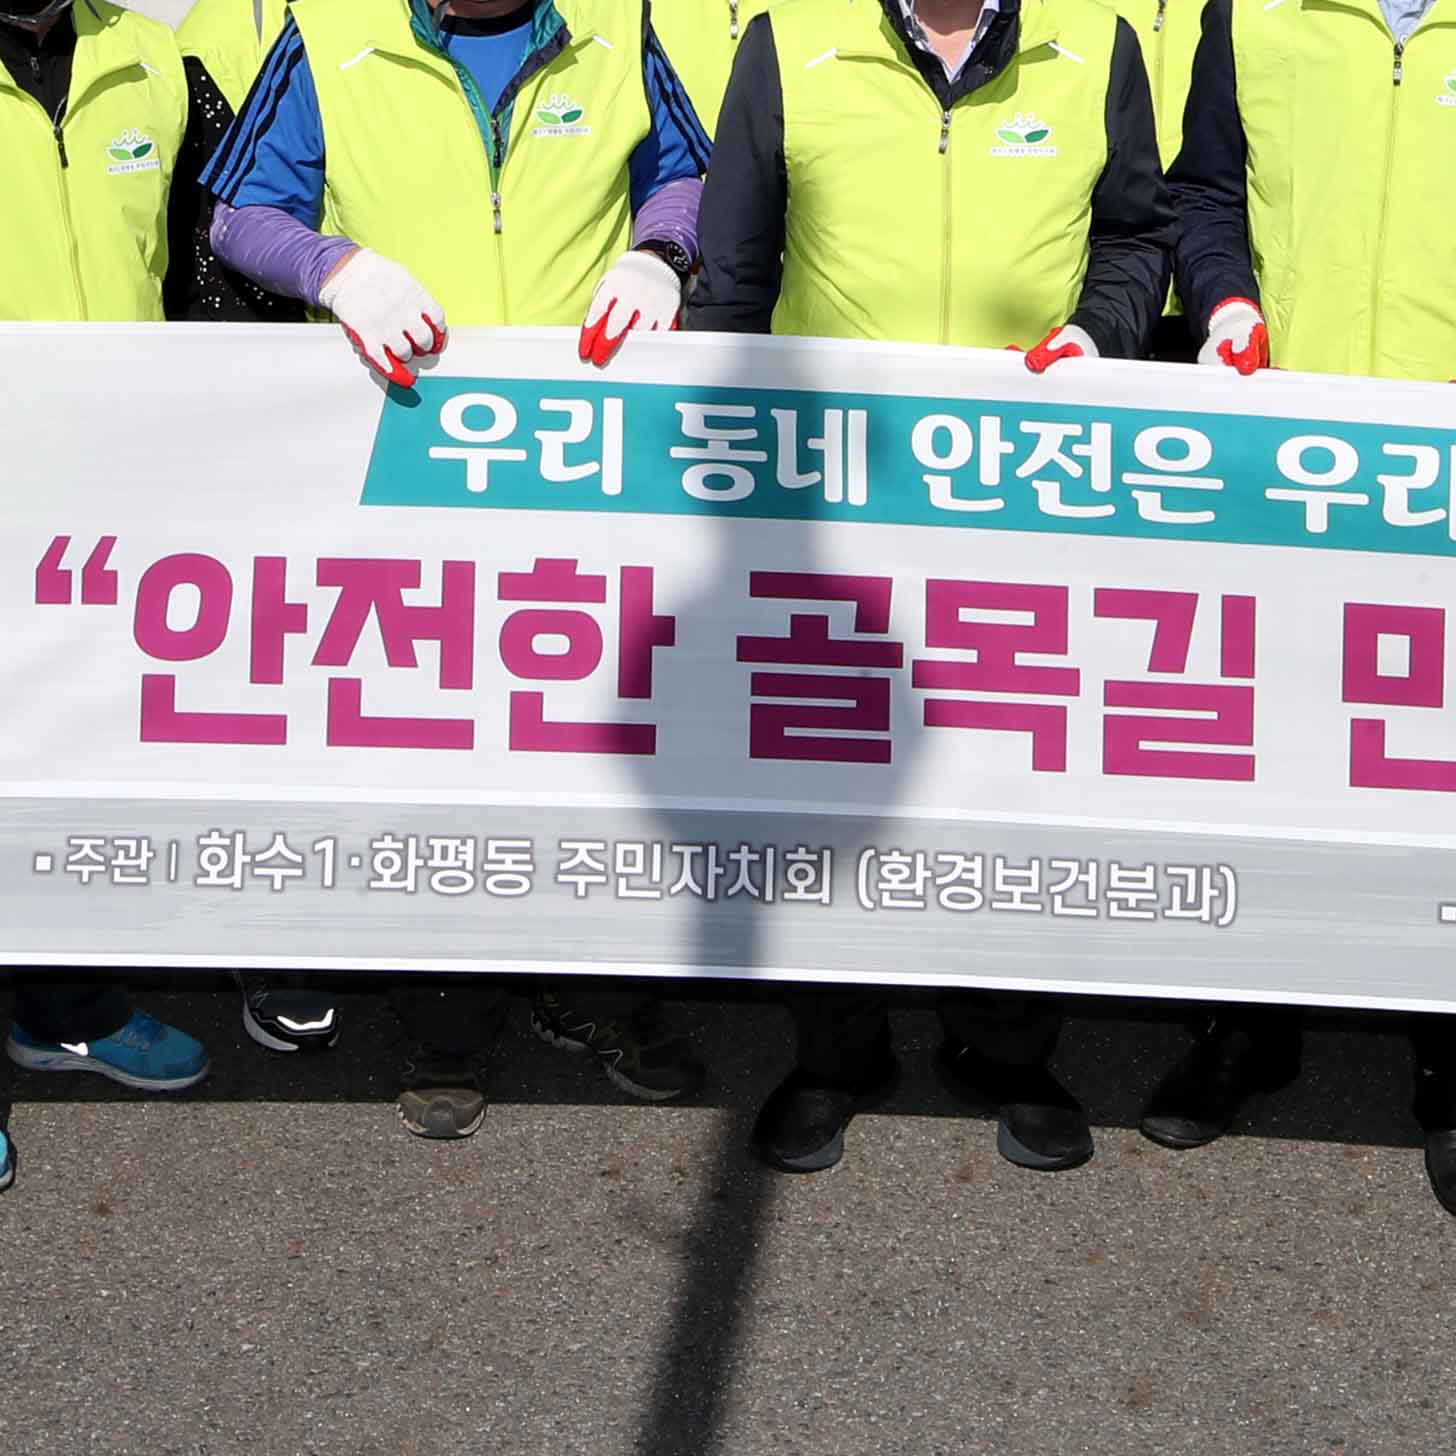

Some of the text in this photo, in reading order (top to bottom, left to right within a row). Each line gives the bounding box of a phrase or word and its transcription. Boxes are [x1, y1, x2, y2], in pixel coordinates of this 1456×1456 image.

[428, 391, 623, 496] 우리
[669, 400, 867, 506] 동네
[910, 412, 1225, 525] 안전은
[35, 535, 676, 756] “안전한
[736, 571, 1256, 782] 골목길
[195, 829, 536, 898] 화수1·화평동
[556, 838, 834, 910] 주민자치회
[856, 846, 1238, 928] (환경보건분과)
